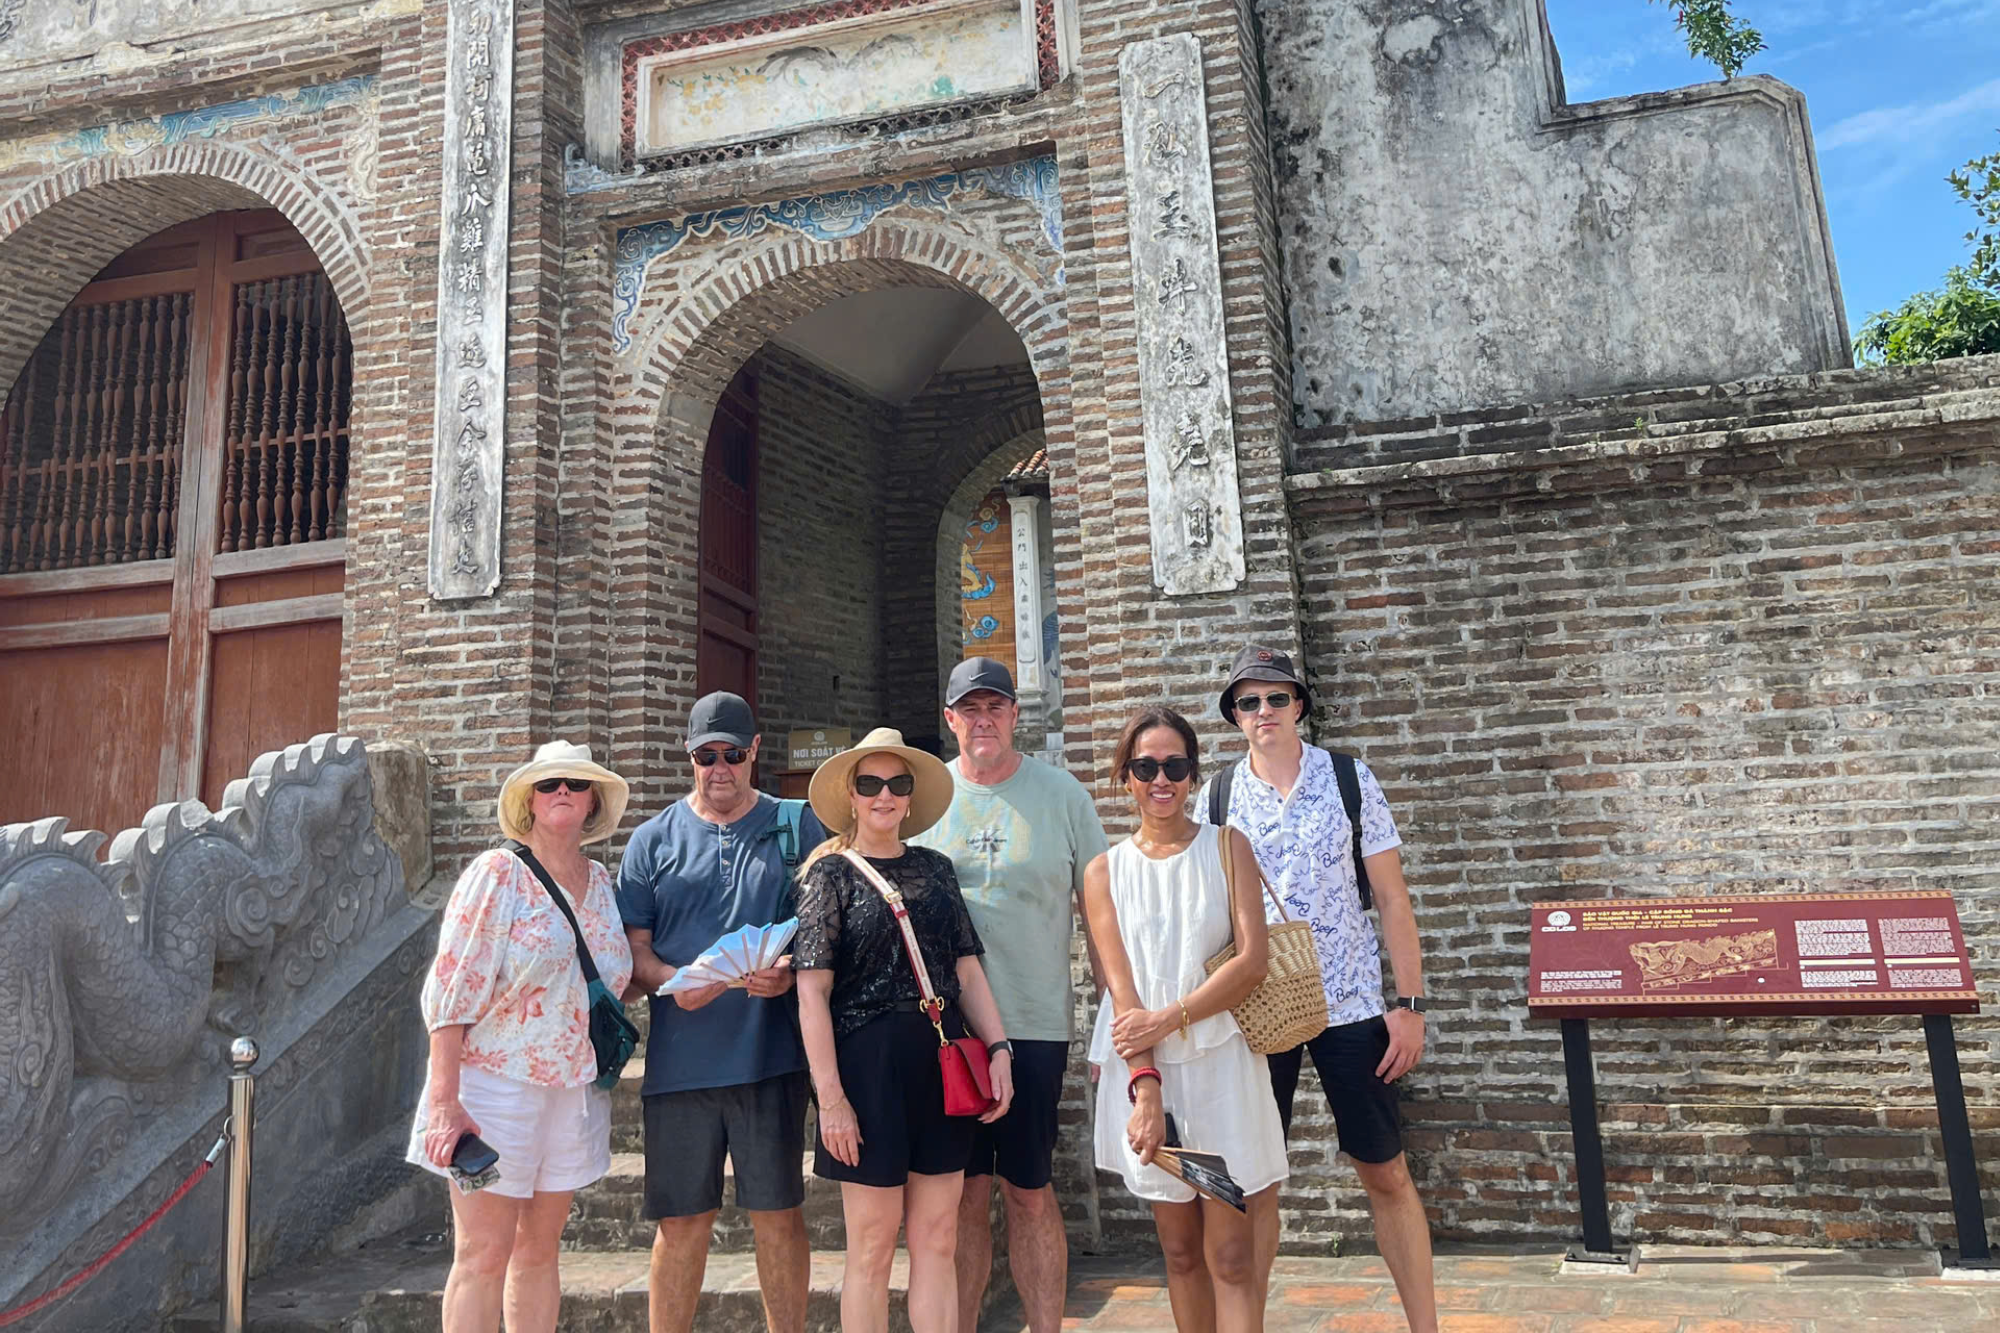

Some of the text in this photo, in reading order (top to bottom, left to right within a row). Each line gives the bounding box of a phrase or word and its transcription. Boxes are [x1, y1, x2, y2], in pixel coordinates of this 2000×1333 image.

[811, 745, 833, 758] SOÁT
[1297, 787, 1324, 806] Beep
[1310, 917, 1338, 938] Beep
